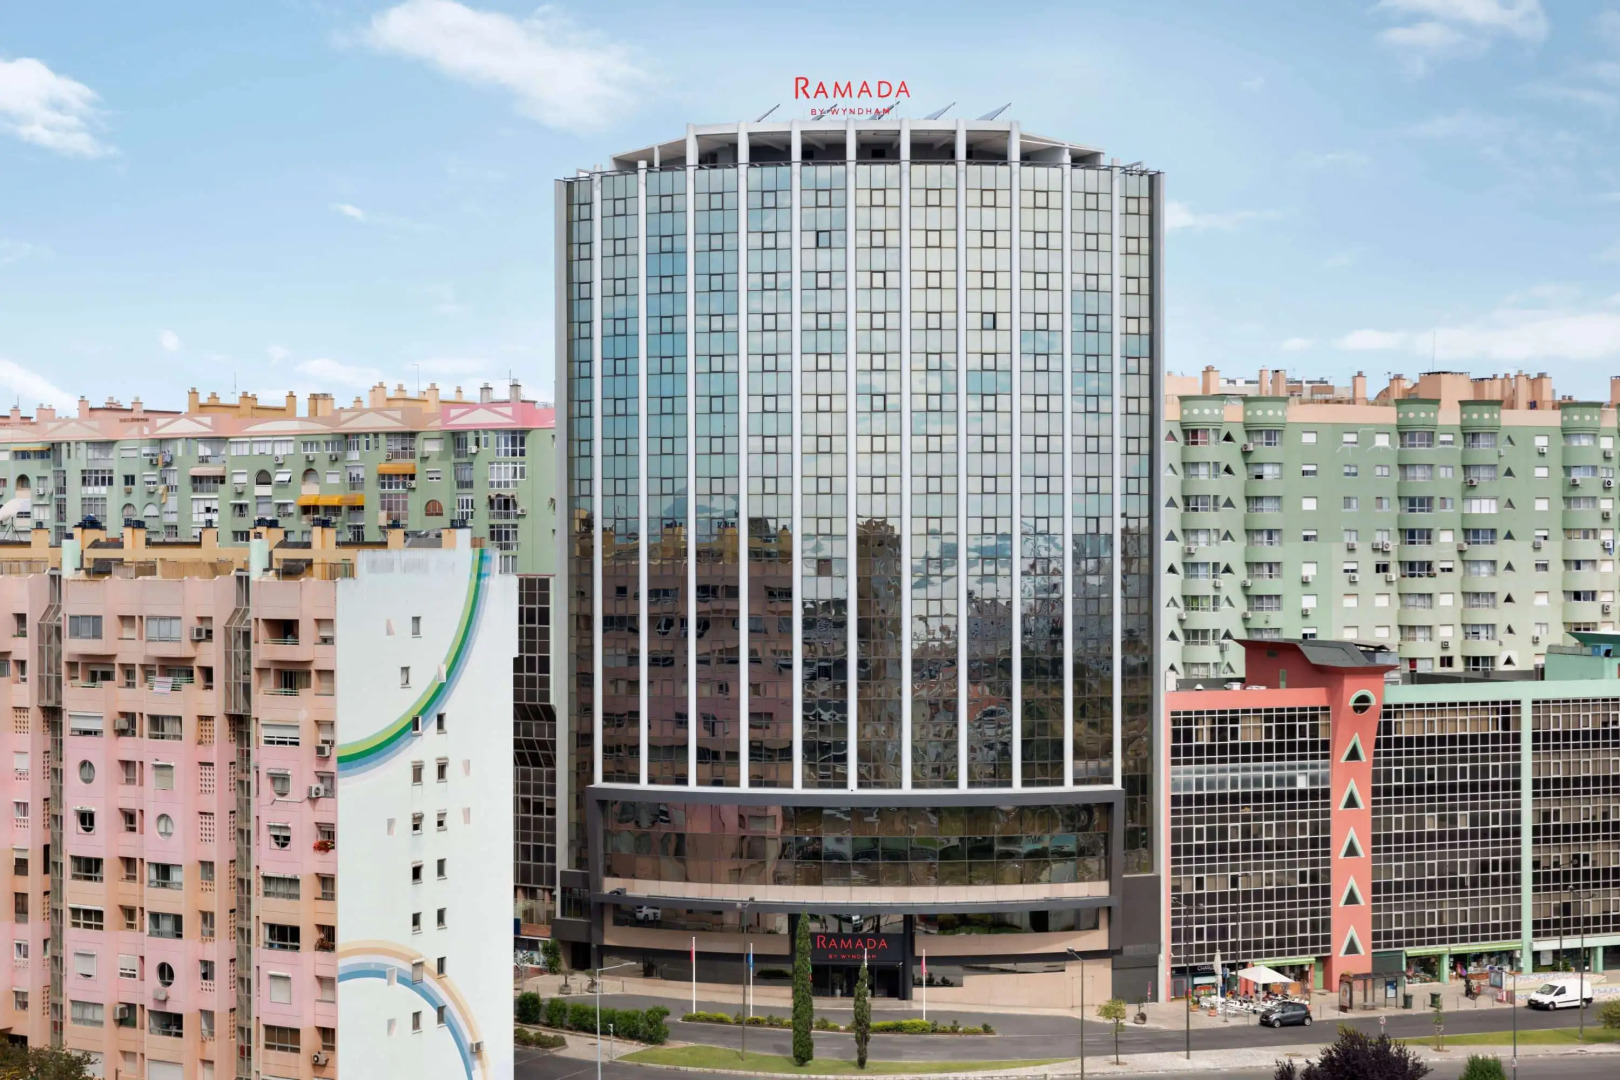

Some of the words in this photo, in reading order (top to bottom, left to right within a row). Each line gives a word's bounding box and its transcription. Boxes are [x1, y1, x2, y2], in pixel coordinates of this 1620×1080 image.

[795, 77, 911, 100] RAMADA
[811, 108, 825, 116] BY
[831, 107, 891, 116] WYNDHAM
[816, 935, 888, 949] RAMADA
